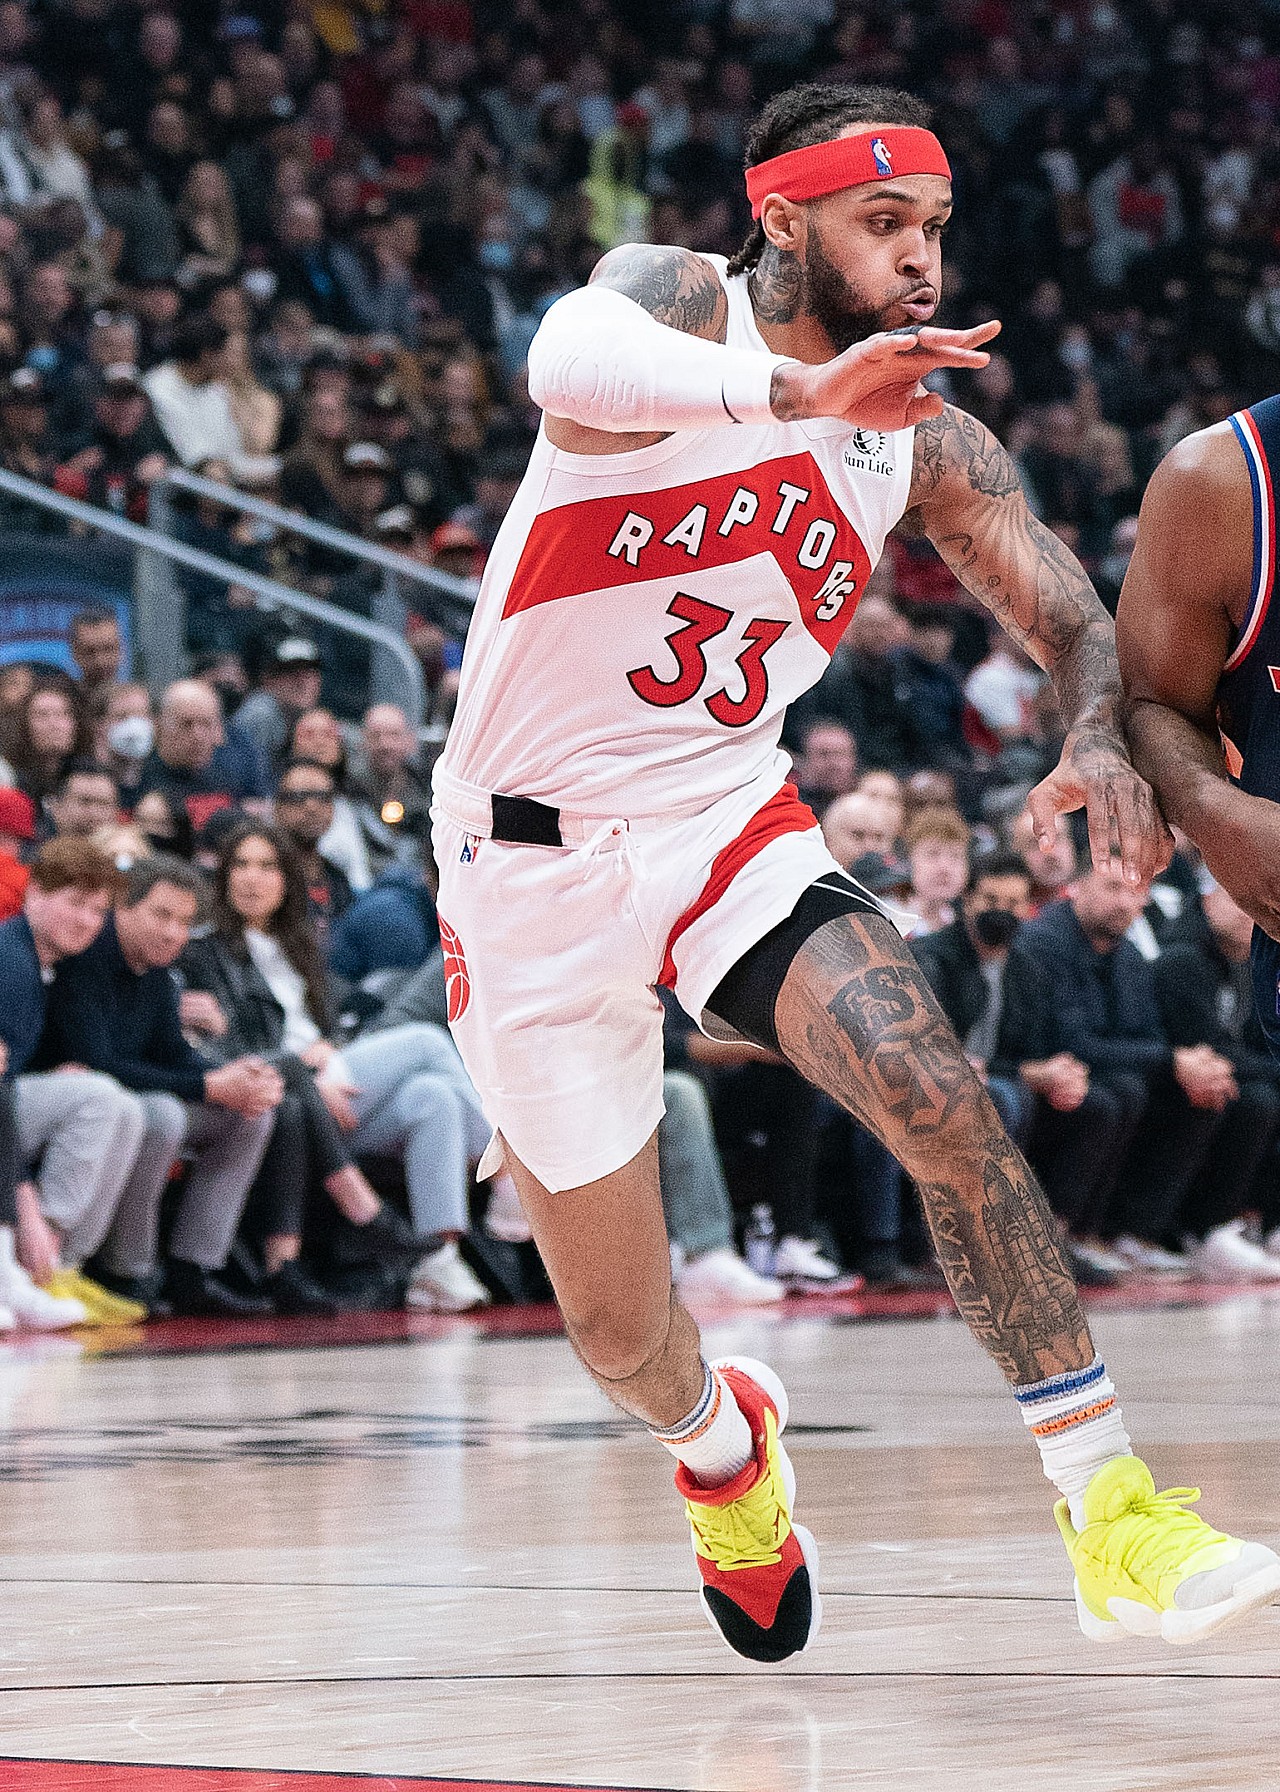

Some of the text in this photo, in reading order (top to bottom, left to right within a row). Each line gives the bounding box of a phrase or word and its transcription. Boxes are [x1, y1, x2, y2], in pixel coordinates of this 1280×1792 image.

[844, 451, 894, 476] Sun Life
[608, 482, 854, 622] RAPTORS
[626, 591, 792, 728] 33
